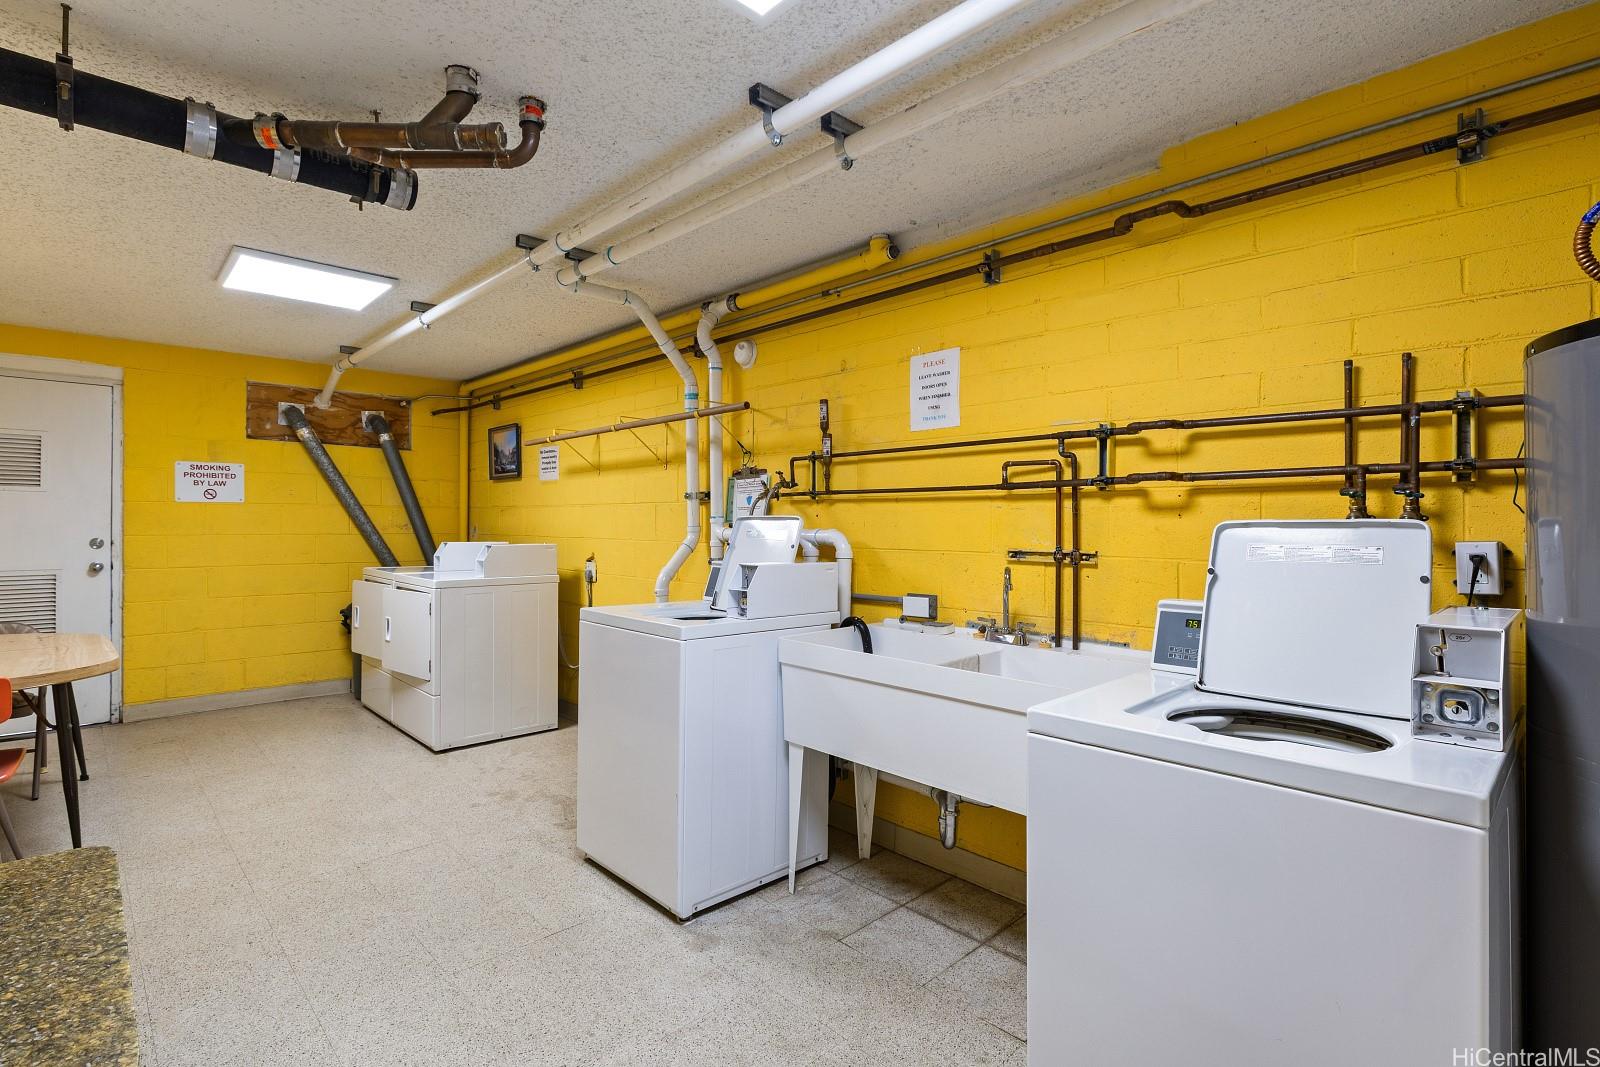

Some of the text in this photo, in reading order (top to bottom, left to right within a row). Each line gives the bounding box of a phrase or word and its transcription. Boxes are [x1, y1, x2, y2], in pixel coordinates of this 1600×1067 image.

[922, 359, 945, 368] PLEASE
[189, 464, 231, 472] SMOKING
[183, 471, 237, 479] PROHIBITED
[1188, 620, 1198, 628] 75
